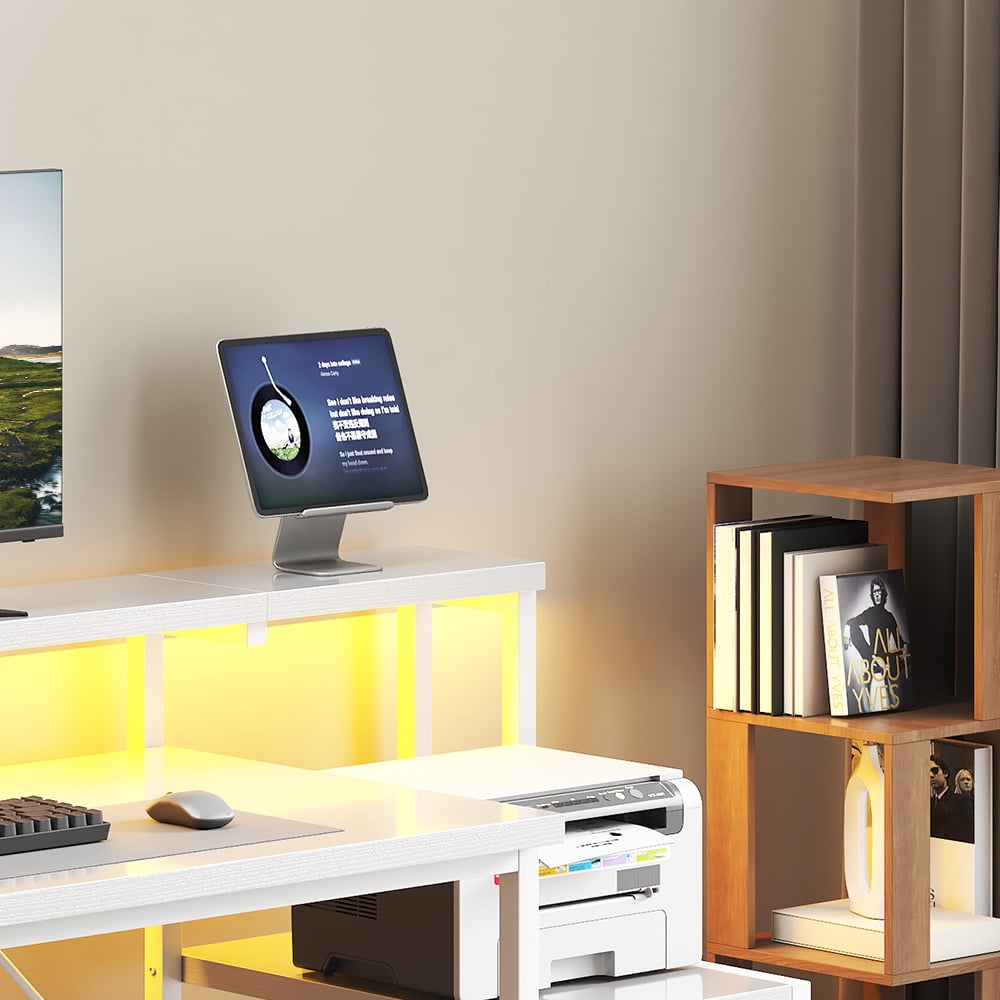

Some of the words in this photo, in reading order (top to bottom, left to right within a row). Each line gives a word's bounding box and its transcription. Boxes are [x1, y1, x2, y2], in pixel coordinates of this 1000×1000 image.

[824, 588, 834, 612] ALL
[827, 619, 840, 667] ABOUT
[874, 627, 907, 654] ALL
[848, 654, 911, 686] ABOUT
[833, 674, 843, 709] YVES
[852, 684, 900, 713] YVES
